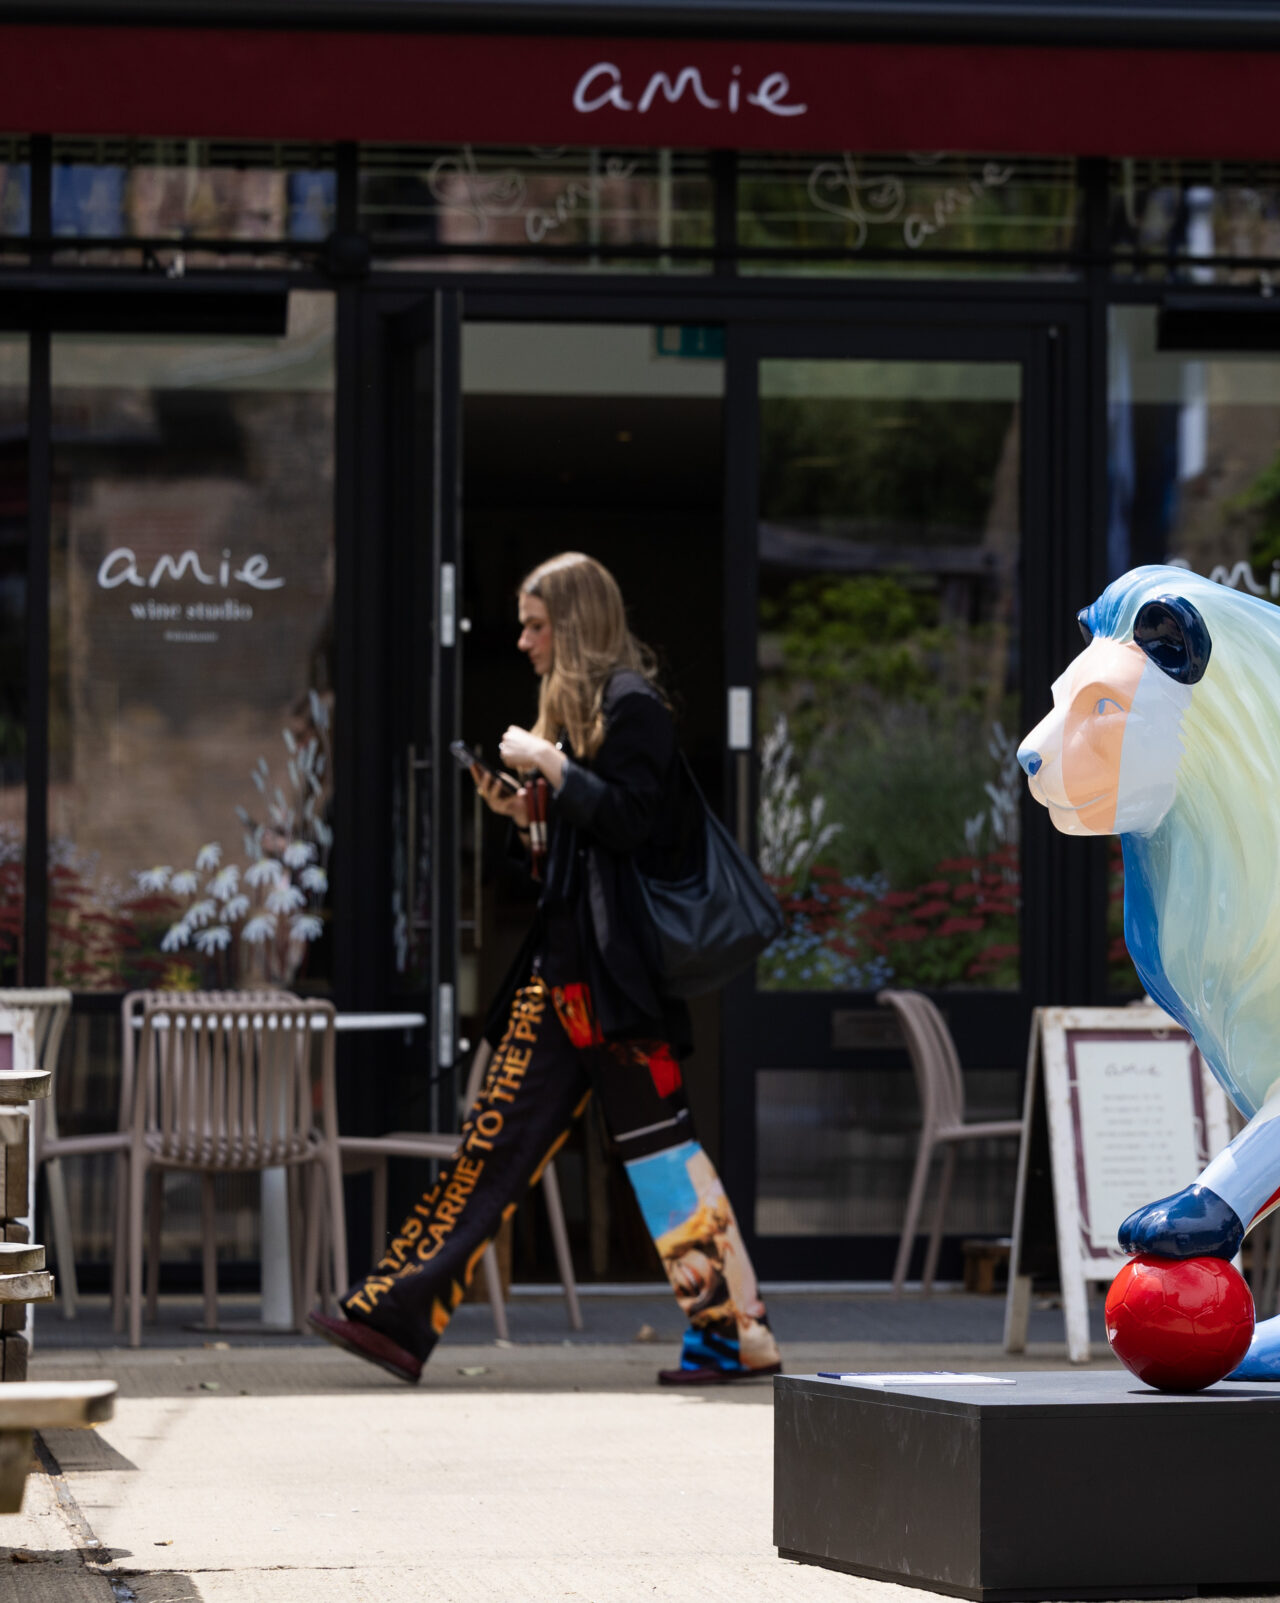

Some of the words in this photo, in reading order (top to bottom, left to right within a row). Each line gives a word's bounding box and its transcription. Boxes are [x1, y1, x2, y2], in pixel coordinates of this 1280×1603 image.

[573, 61, 808, 117] amie
[97, 547, 286, 590] amie
[130, 599, 181, 621] wine
[185, 598, 253, 622] studio
[416, 1155, 485, 1261] CARRIE
[466, 1109, 504, 1152] TO
[488, 1045, 533, 1105] THE
